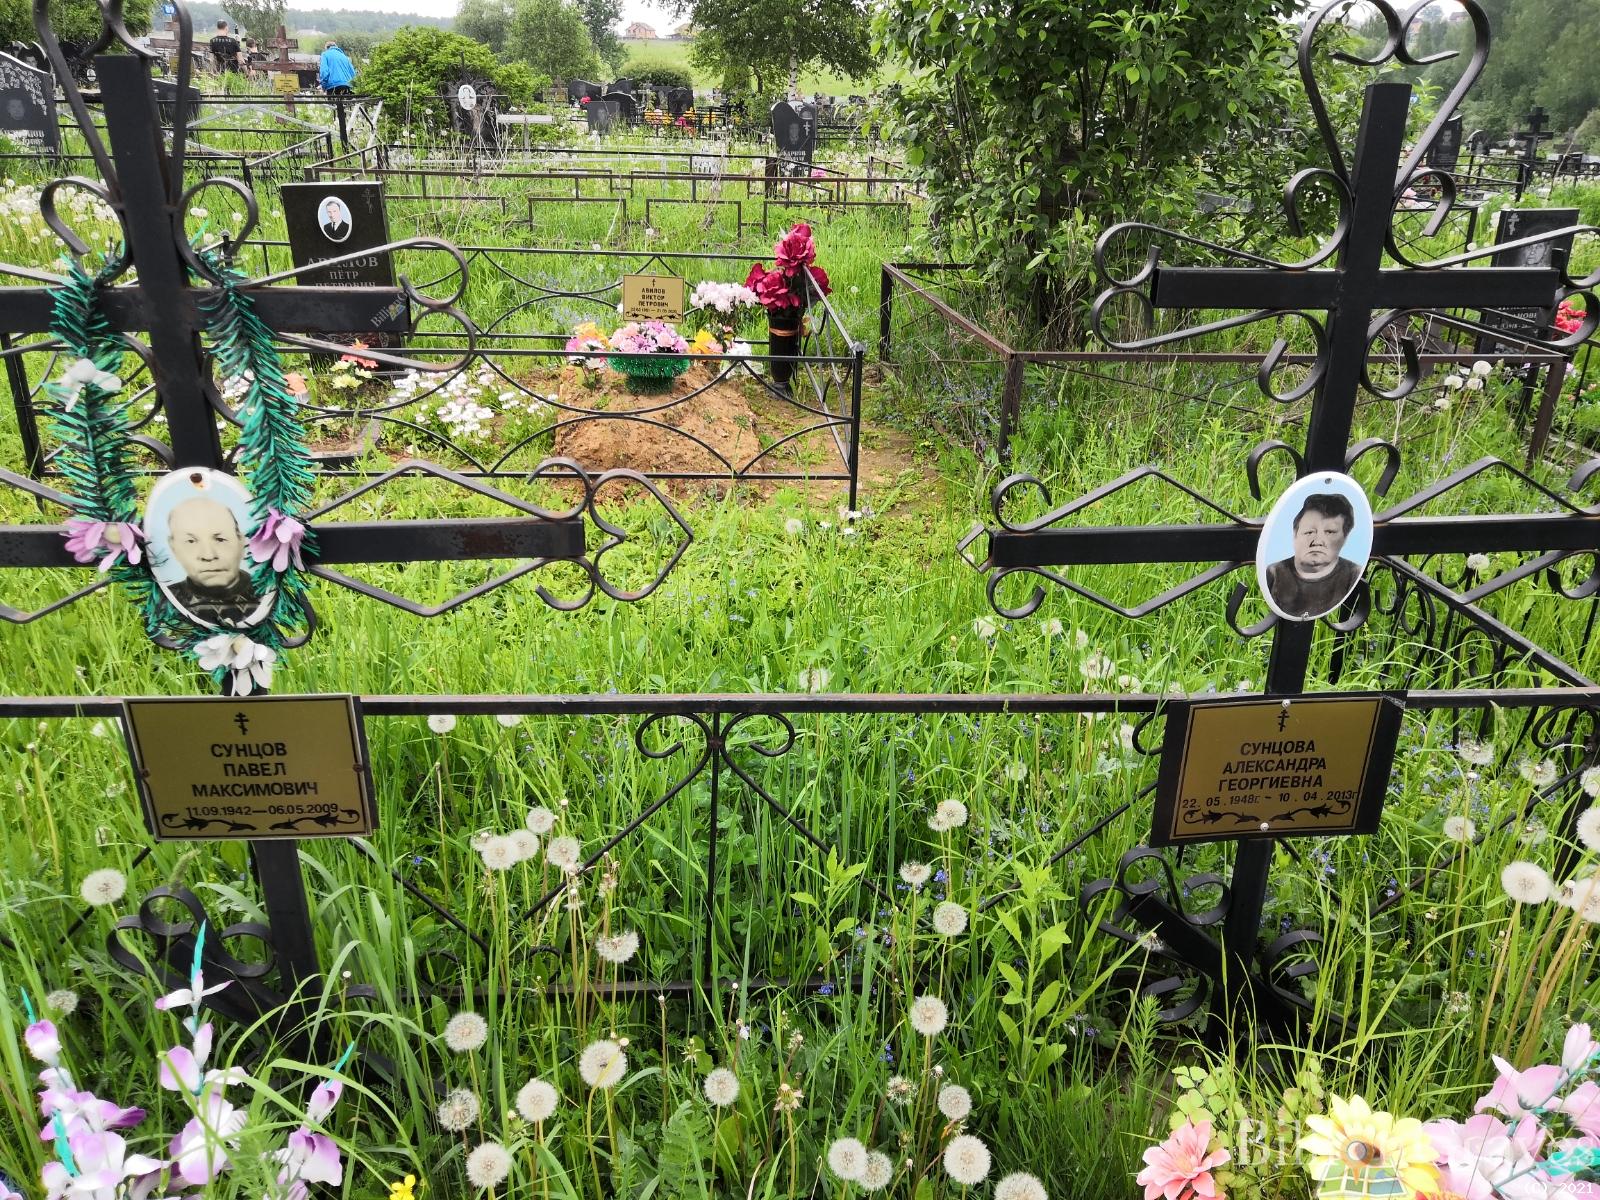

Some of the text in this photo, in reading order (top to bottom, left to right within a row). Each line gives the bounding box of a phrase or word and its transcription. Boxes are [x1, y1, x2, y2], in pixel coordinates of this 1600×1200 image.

[329, 269, 359, 280] ПЁТР
[210, 742, 287, 759] СУНЦОВ
[1240, 740, 1316, 757] СУНЦОВА
[223, 762, 287, 778] ПАВЕЛ
[1222, 758, 1327, 775] АЛЕКСАНДРА
[191, 781, 319, 798] МАКСИМОВИЧ
[1218, 775, 1323, 792] ГЕОРГИЕВНА
